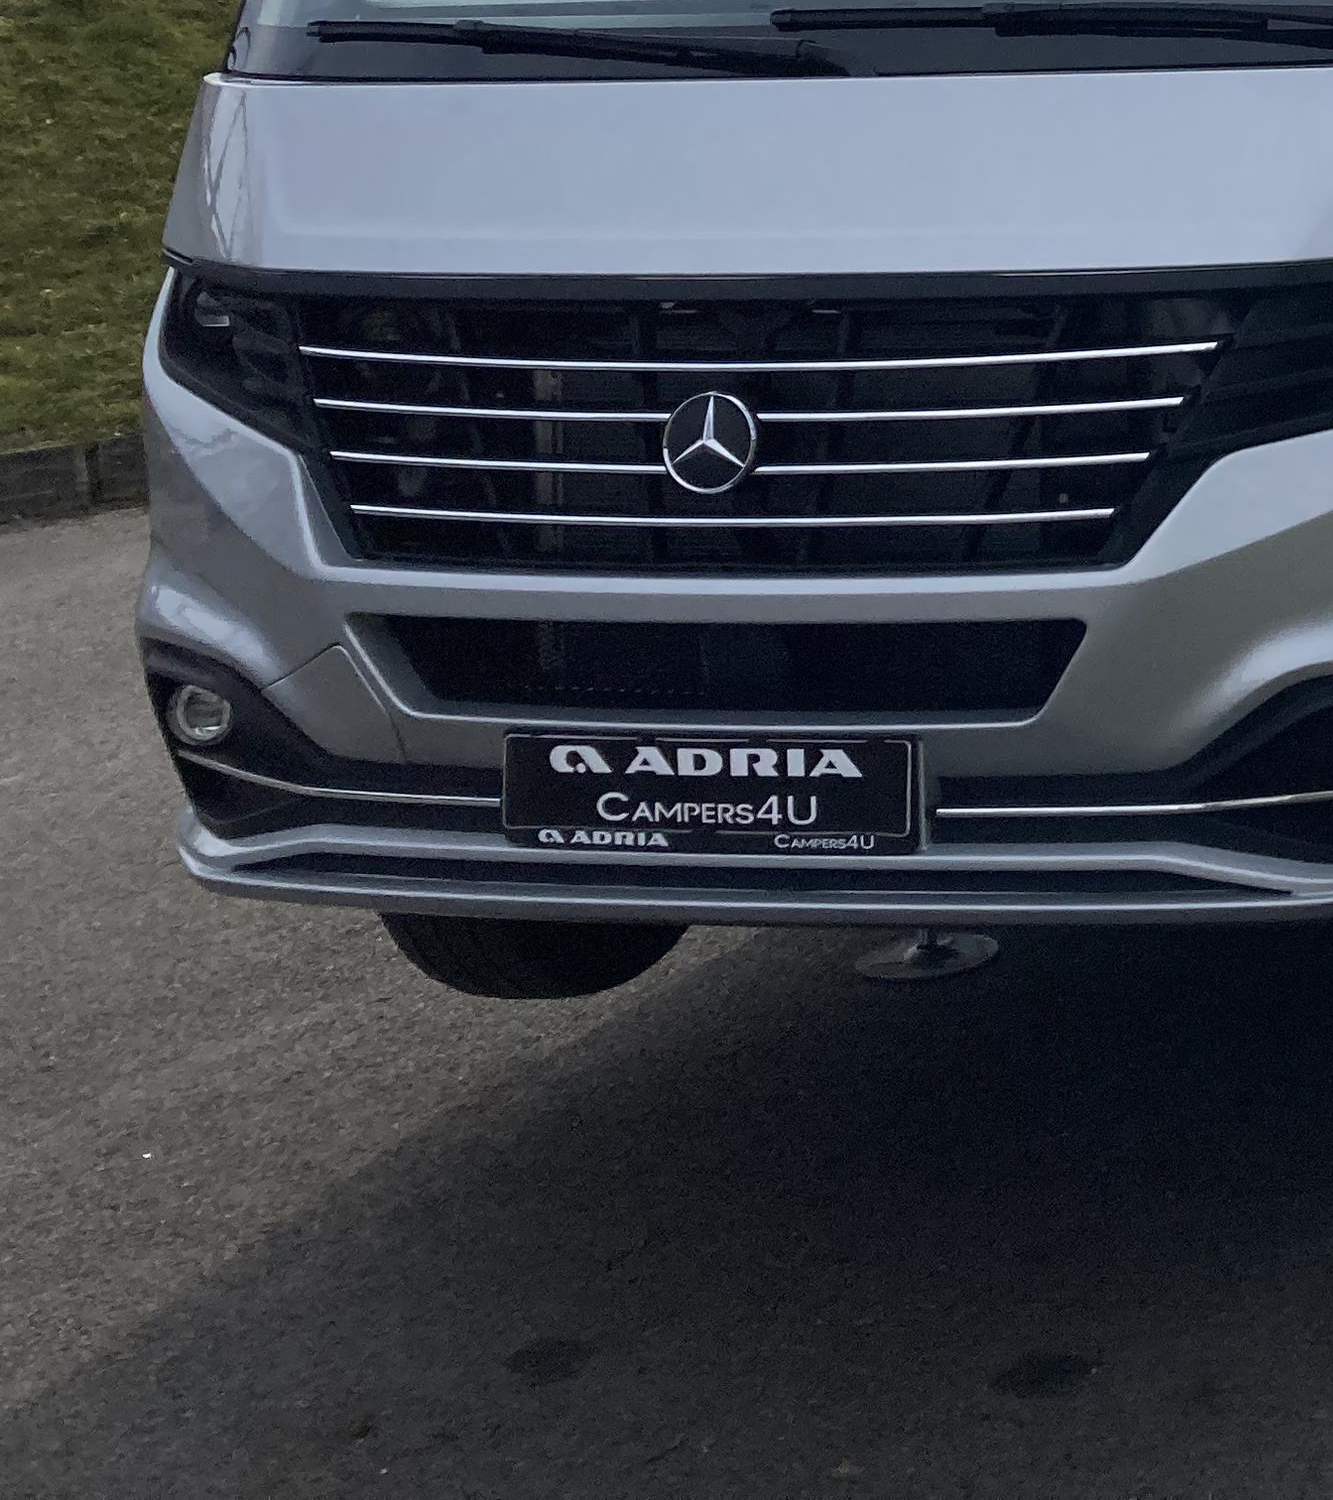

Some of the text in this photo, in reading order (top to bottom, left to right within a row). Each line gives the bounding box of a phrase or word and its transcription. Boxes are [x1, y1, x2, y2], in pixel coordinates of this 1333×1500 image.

[624, 746, 864, 778] ADRIA
[595, 791, 818, 826] CAMPERS4U
[569, 830, 670, 847] ADRIA
[773, 833, 875, 850] CAMPERS4U
